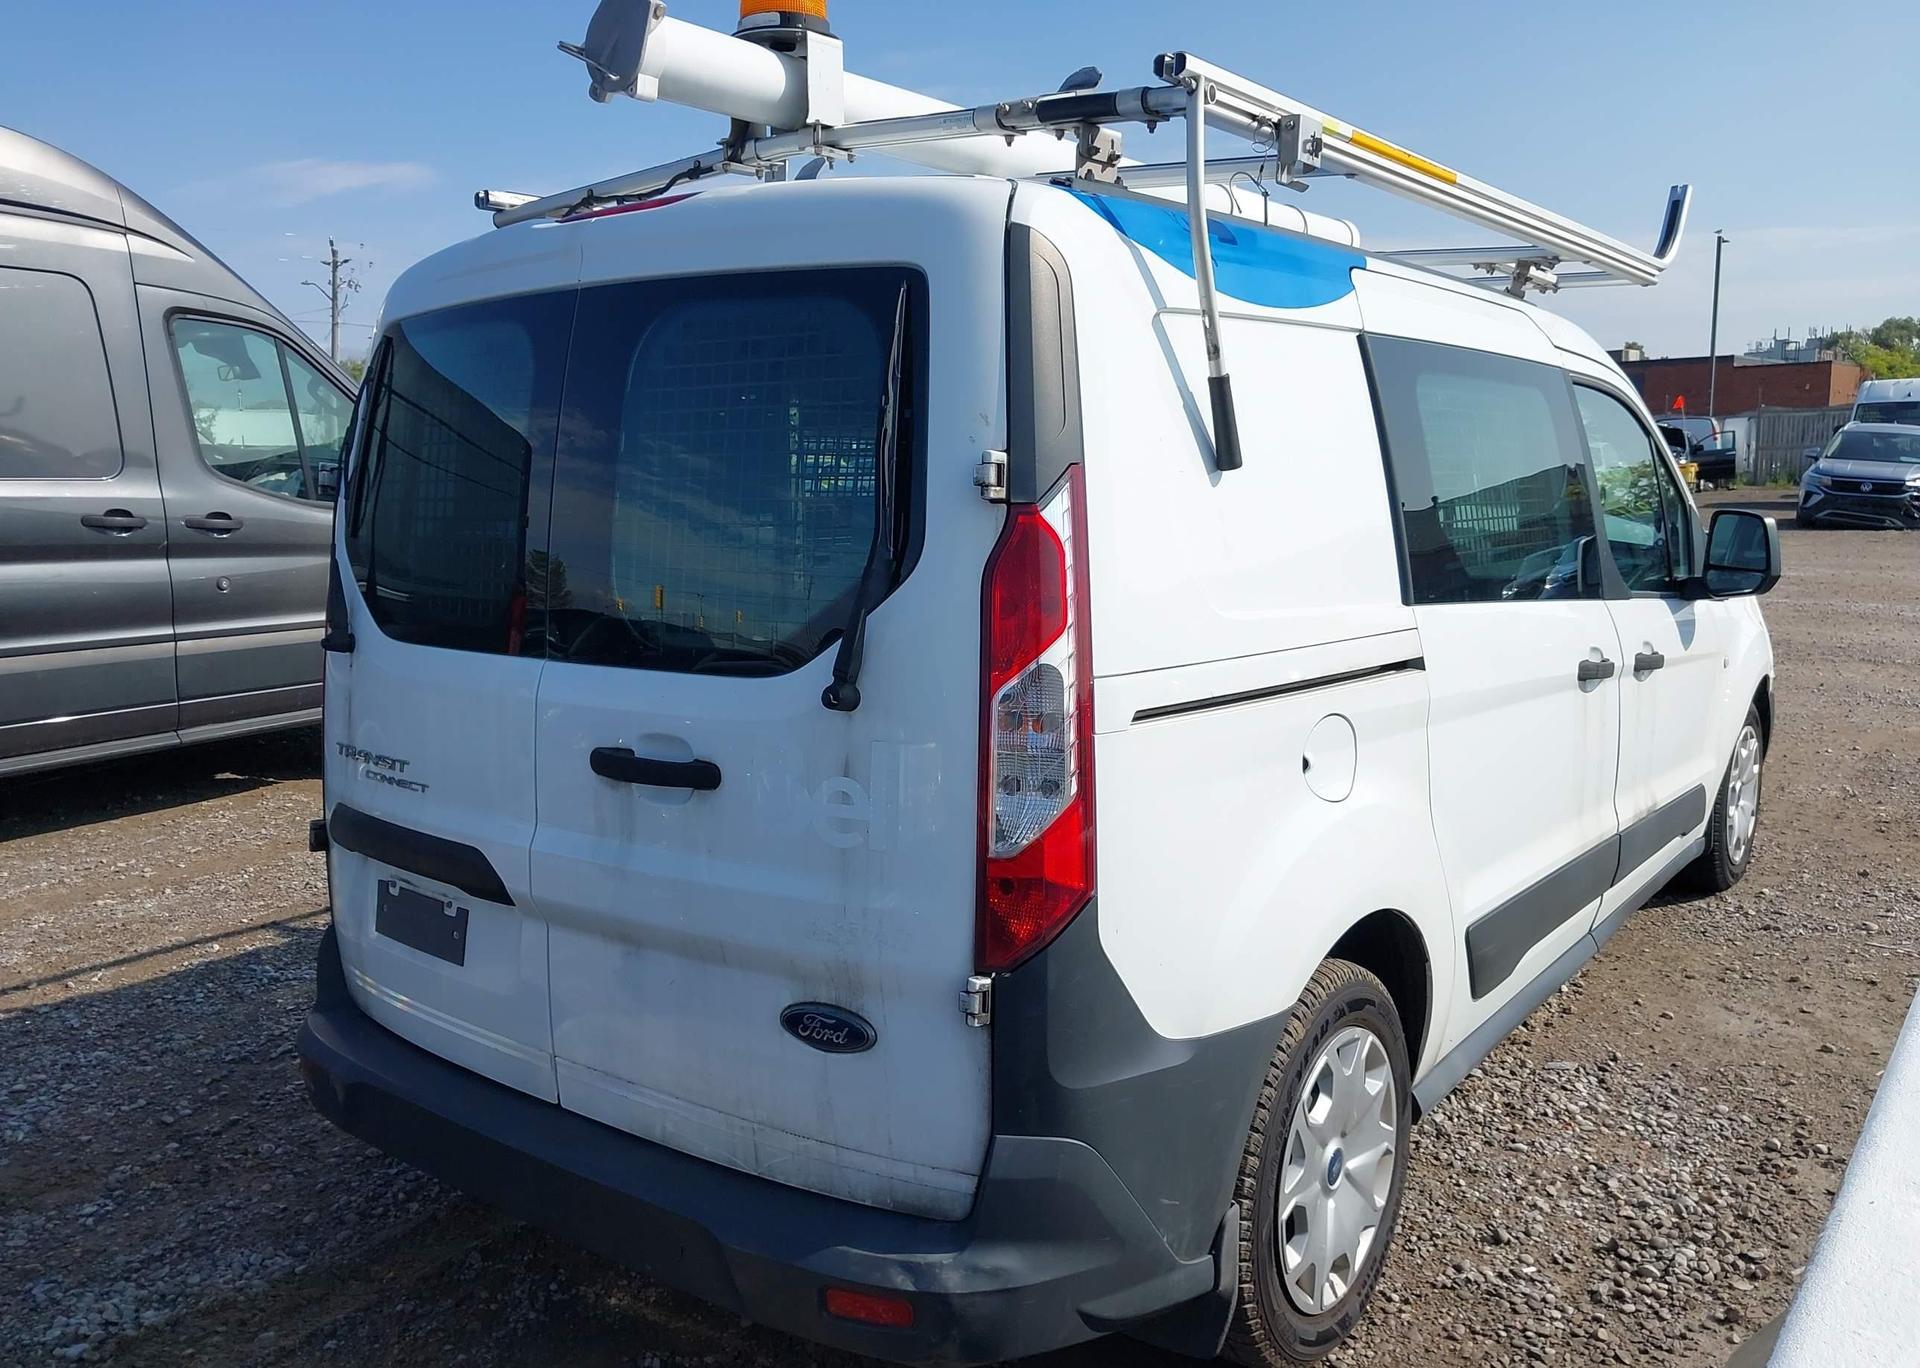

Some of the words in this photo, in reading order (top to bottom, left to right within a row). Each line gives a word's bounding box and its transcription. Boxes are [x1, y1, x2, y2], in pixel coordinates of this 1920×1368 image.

[336, 742, 410, 773] TRANSIT
[365, 769, 430, 794] CONNECT
[798, 1013, 849, 1045] Ford
